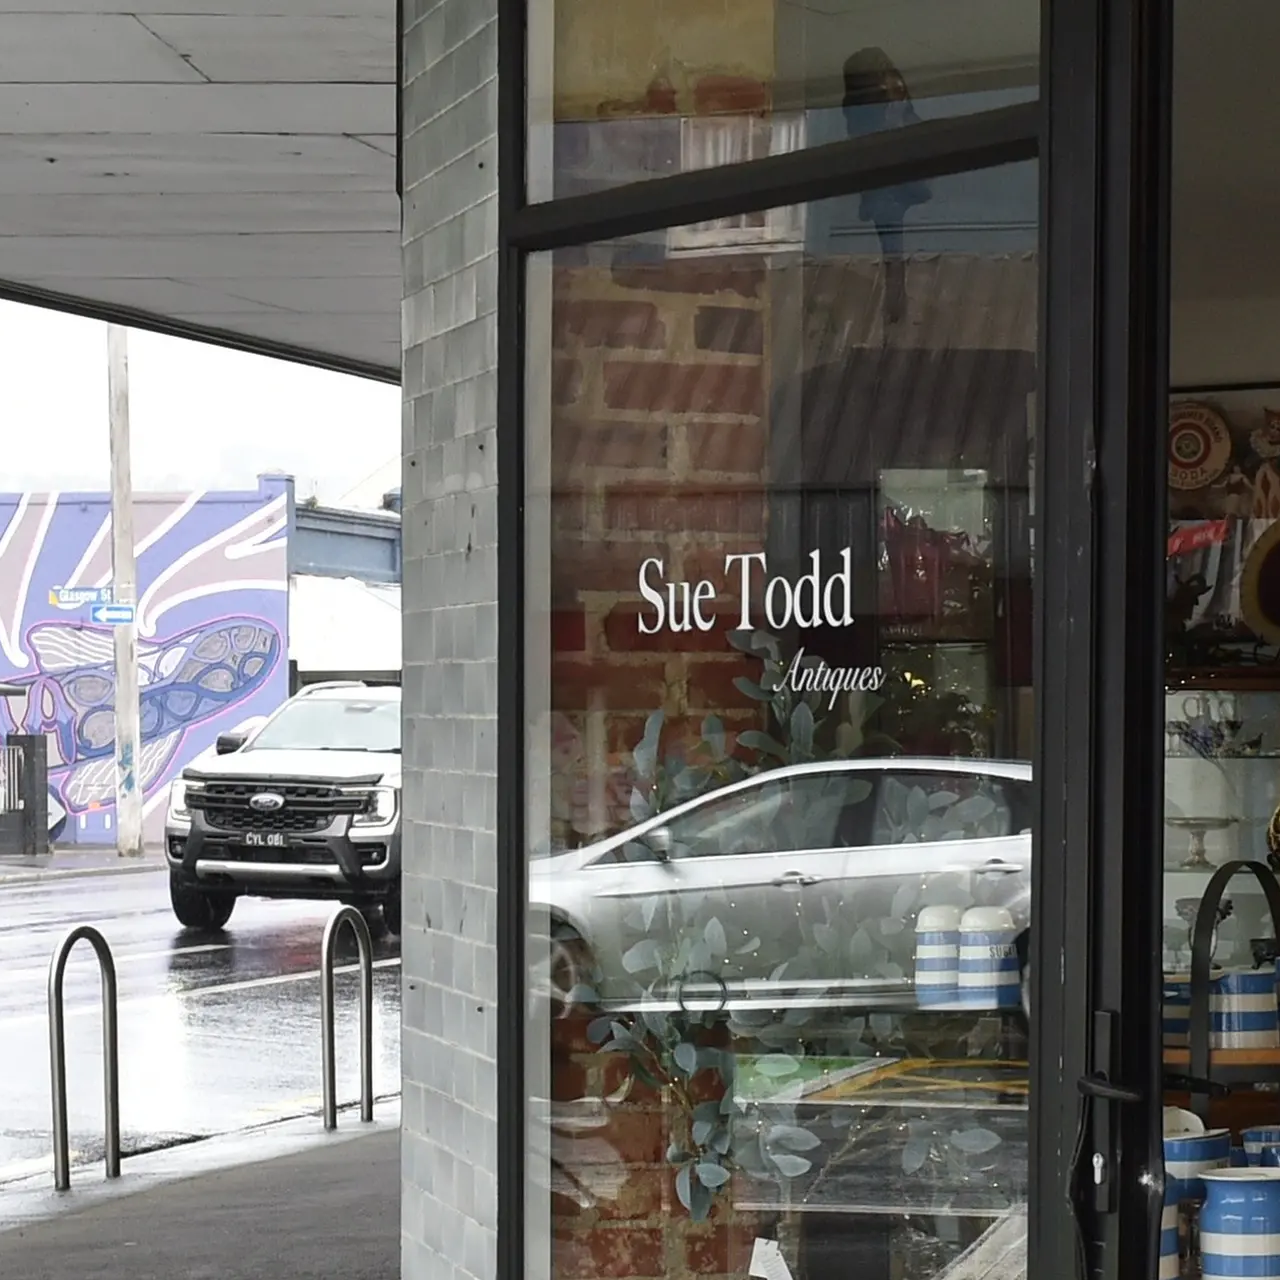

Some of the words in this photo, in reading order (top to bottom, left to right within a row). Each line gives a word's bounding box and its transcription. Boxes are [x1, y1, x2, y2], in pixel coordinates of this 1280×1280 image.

[638, 557, 717, 634] Sue
[724, 547, 855, 631] Todd
[773, 647, 887, 711] Antiques
